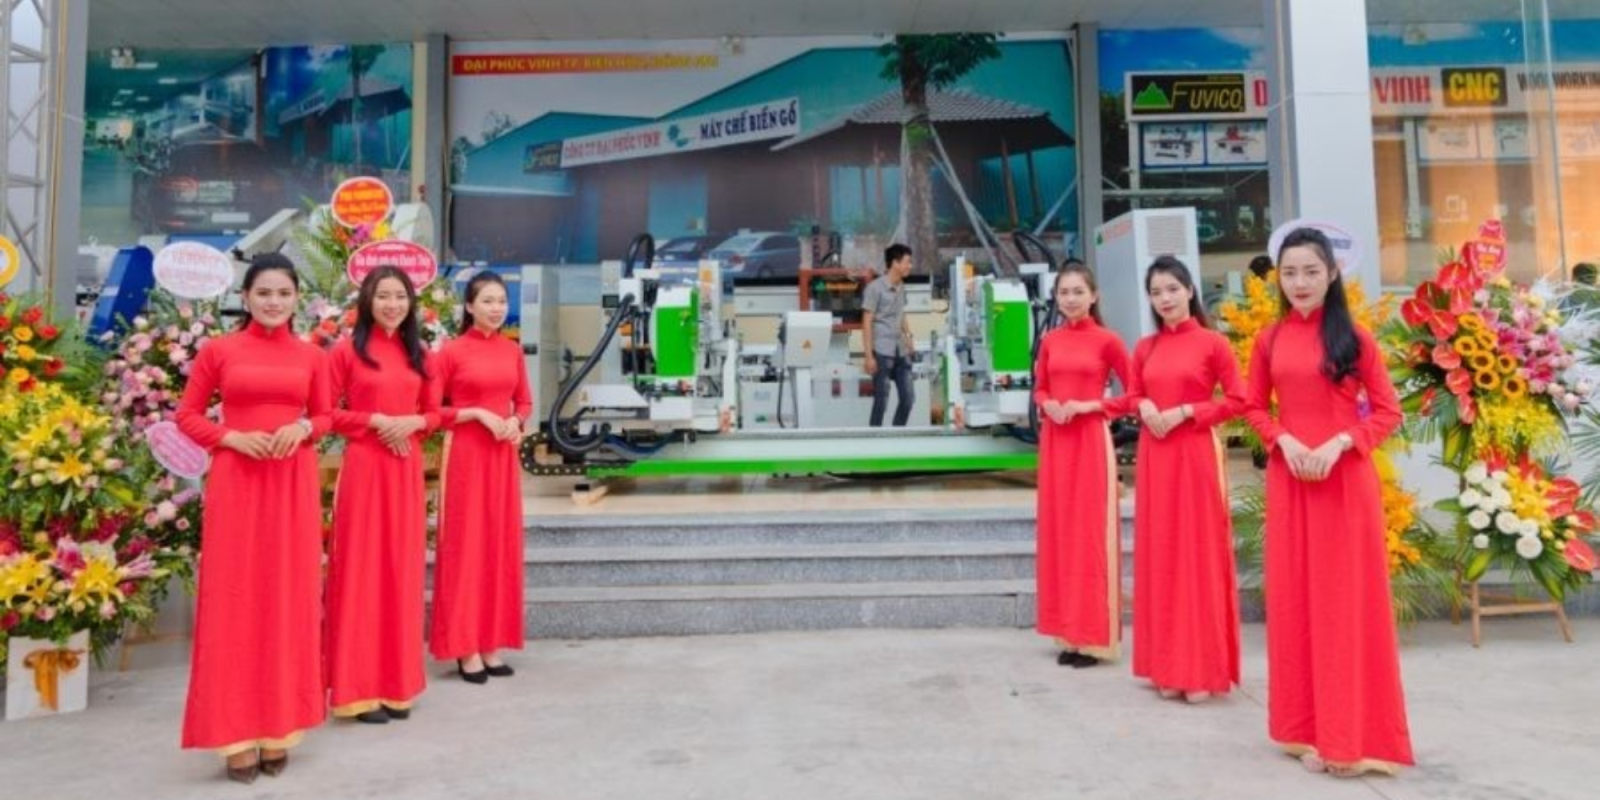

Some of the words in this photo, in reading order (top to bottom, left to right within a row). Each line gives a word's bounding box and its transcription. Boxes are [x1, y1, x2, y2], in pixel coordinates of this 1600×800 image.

[489, 57, 525, 70] PHÚC
[528, 58, 560, 70] VINH
[1373, 75, 1432, 104] VINH
[1448, 71, 1500, 102] CNC
